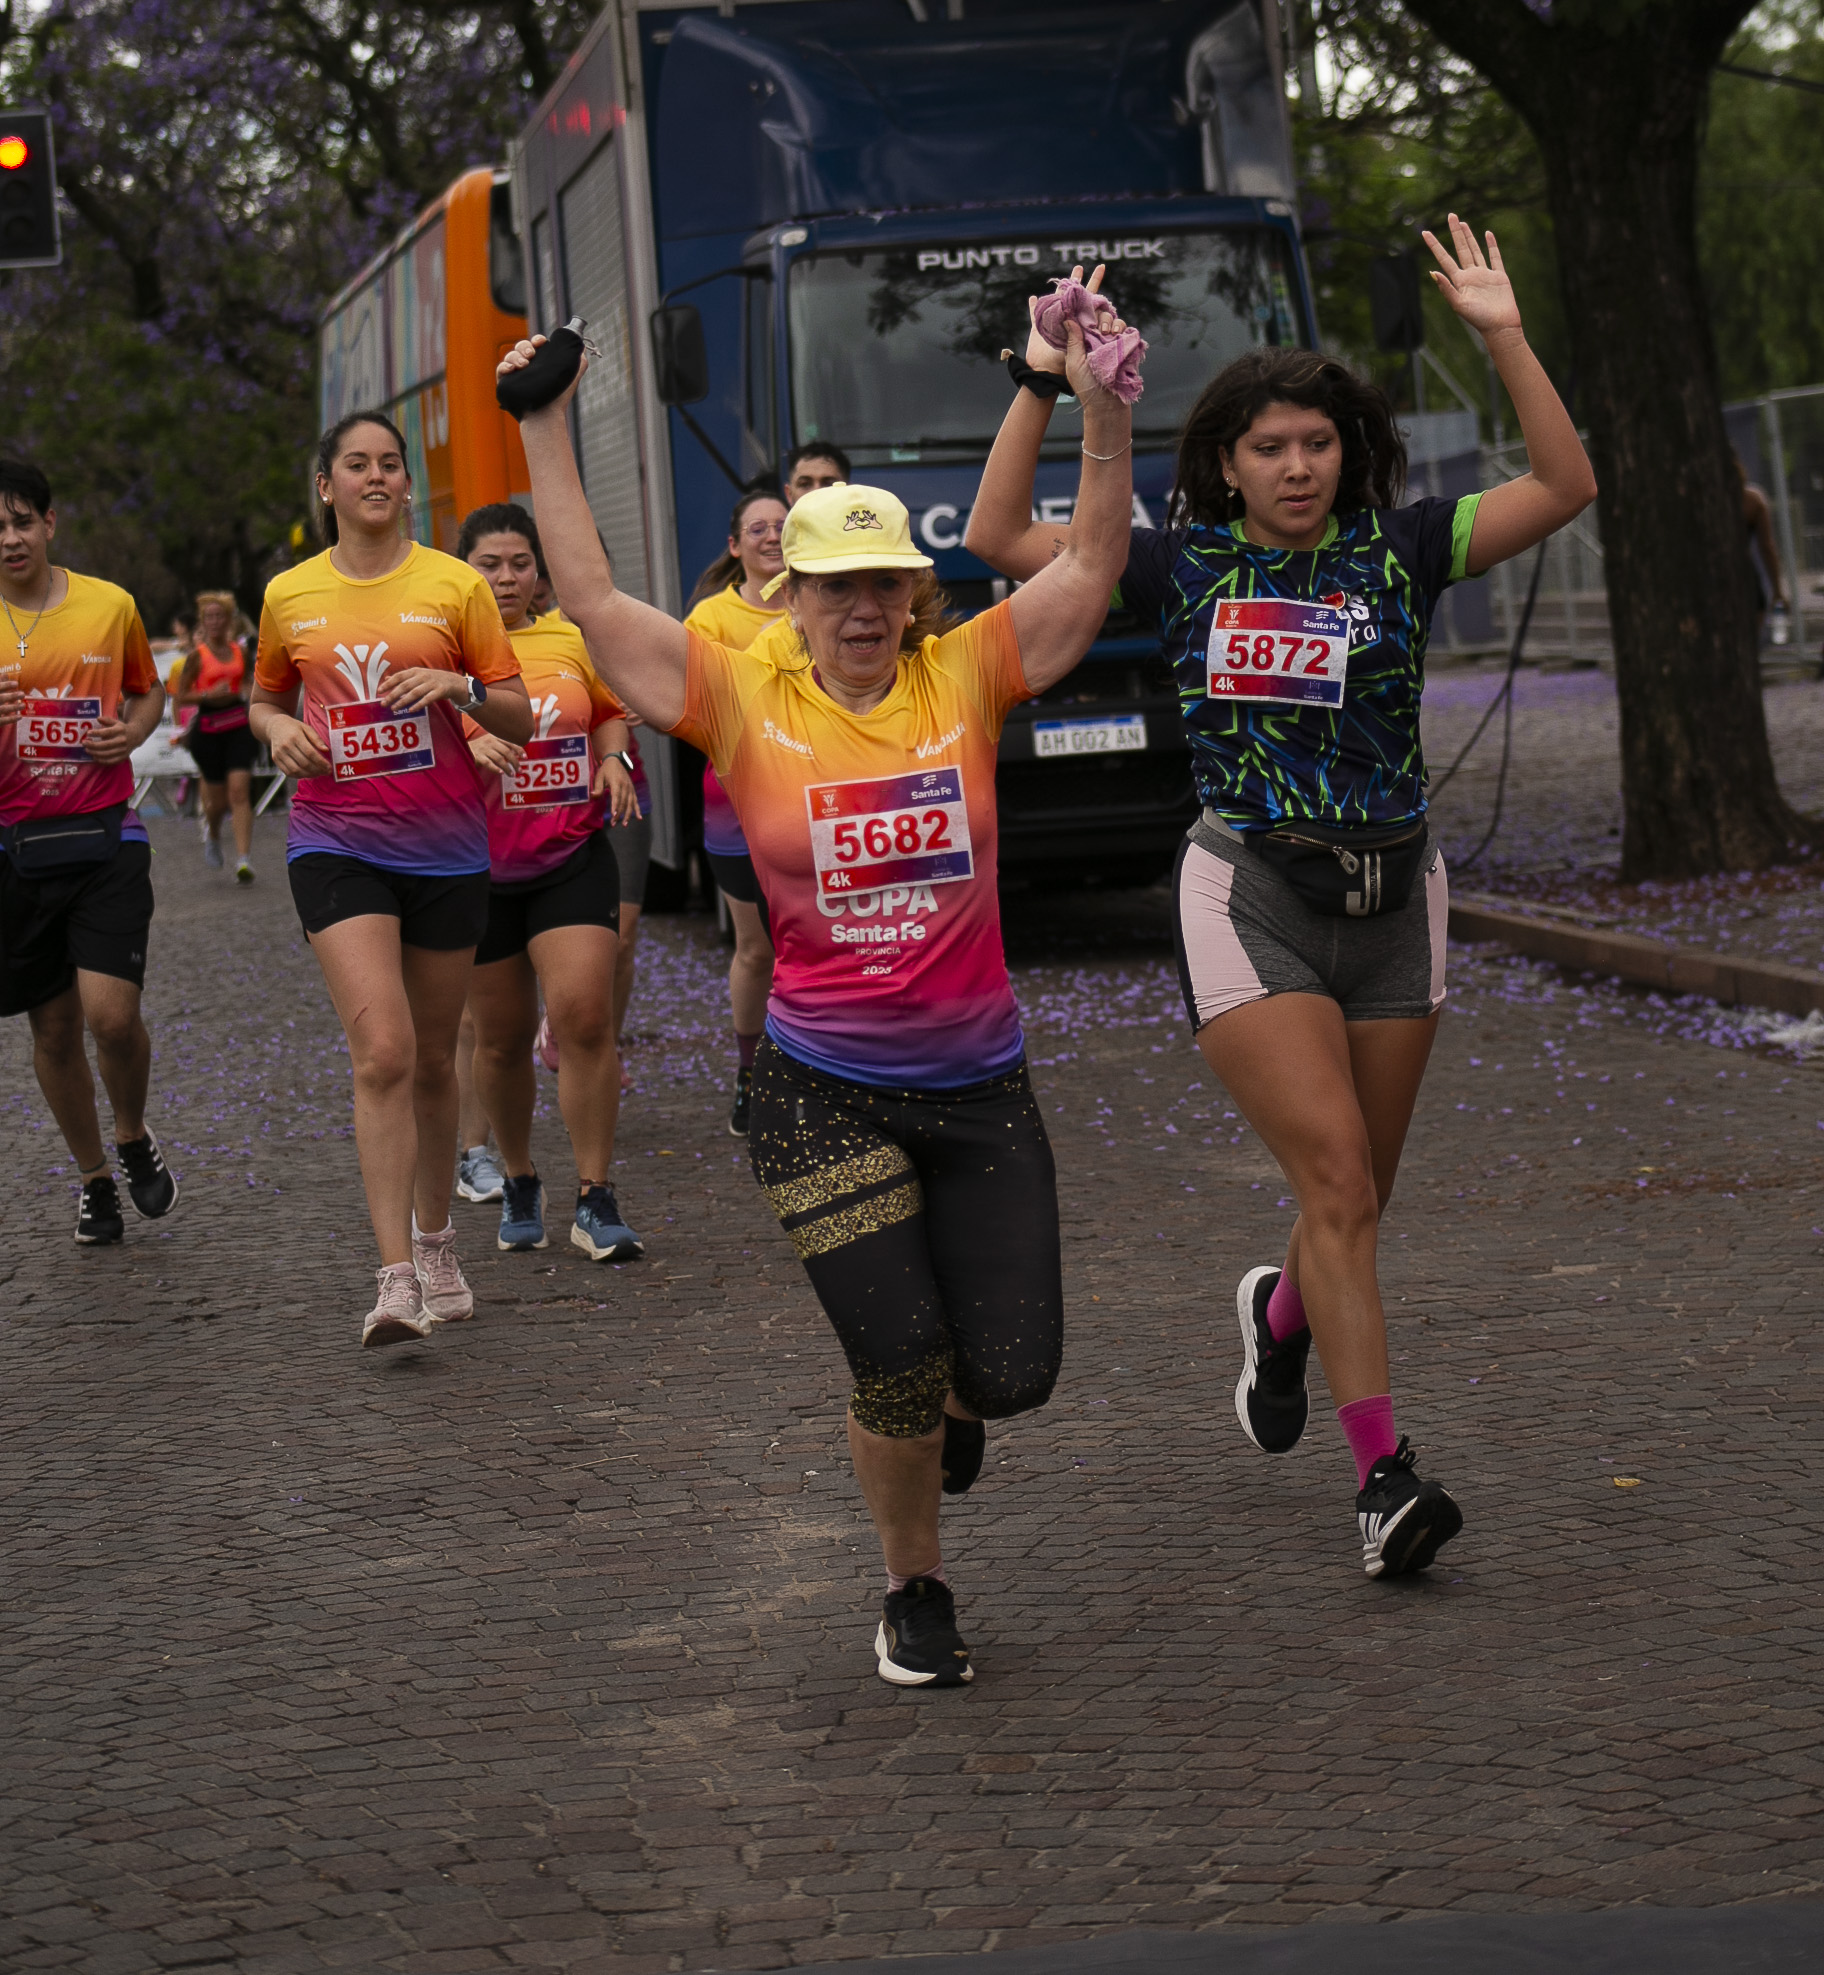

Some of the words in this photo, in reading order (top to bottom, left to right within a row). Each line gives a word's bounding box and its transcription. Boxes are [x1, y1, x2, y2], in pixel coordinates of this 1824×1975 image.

[918, 244, 1039, 271] PUNTO
[1052, 239, 1165, 262] TRUCK
[399, 611, 448, 626] VANDALIA
[1303, 620, 1328, 630] Santa
[1329, 623, 1340, 631] Fe
[1225, 634, 1331, 676] 5872
[1215, 677, 1236, 691] 4k
[29, 720, 93, 744] 5652
[343, 722, 419, 758] 5438
[916, 722, 966, 759] VANDALIA
[1042, 733, 1066, 752] AH
[1071, 730, 1108, 751] 002
[1116, 727, 1140, 748] AN
[23, 747, 37, 757] 4k
[340, 764, 355, 777] 4k
[514, 760, 580, 789] 5259
[510, 793, 525, 804] 4k
[911, 789, 940, 800] Santa
[941, 786, 952, 796] Fe
[834, 810, 952, 863] 5682
[827, 871, 852, 888] 4k
[816, 886, 939, 918] COPA
[831, 924, 898, 943] Santa
[901, 922, 926, 940] Fe
[855, 947, 901, 955] PROVINCIA
[862, 965, 892, 975] 2025
